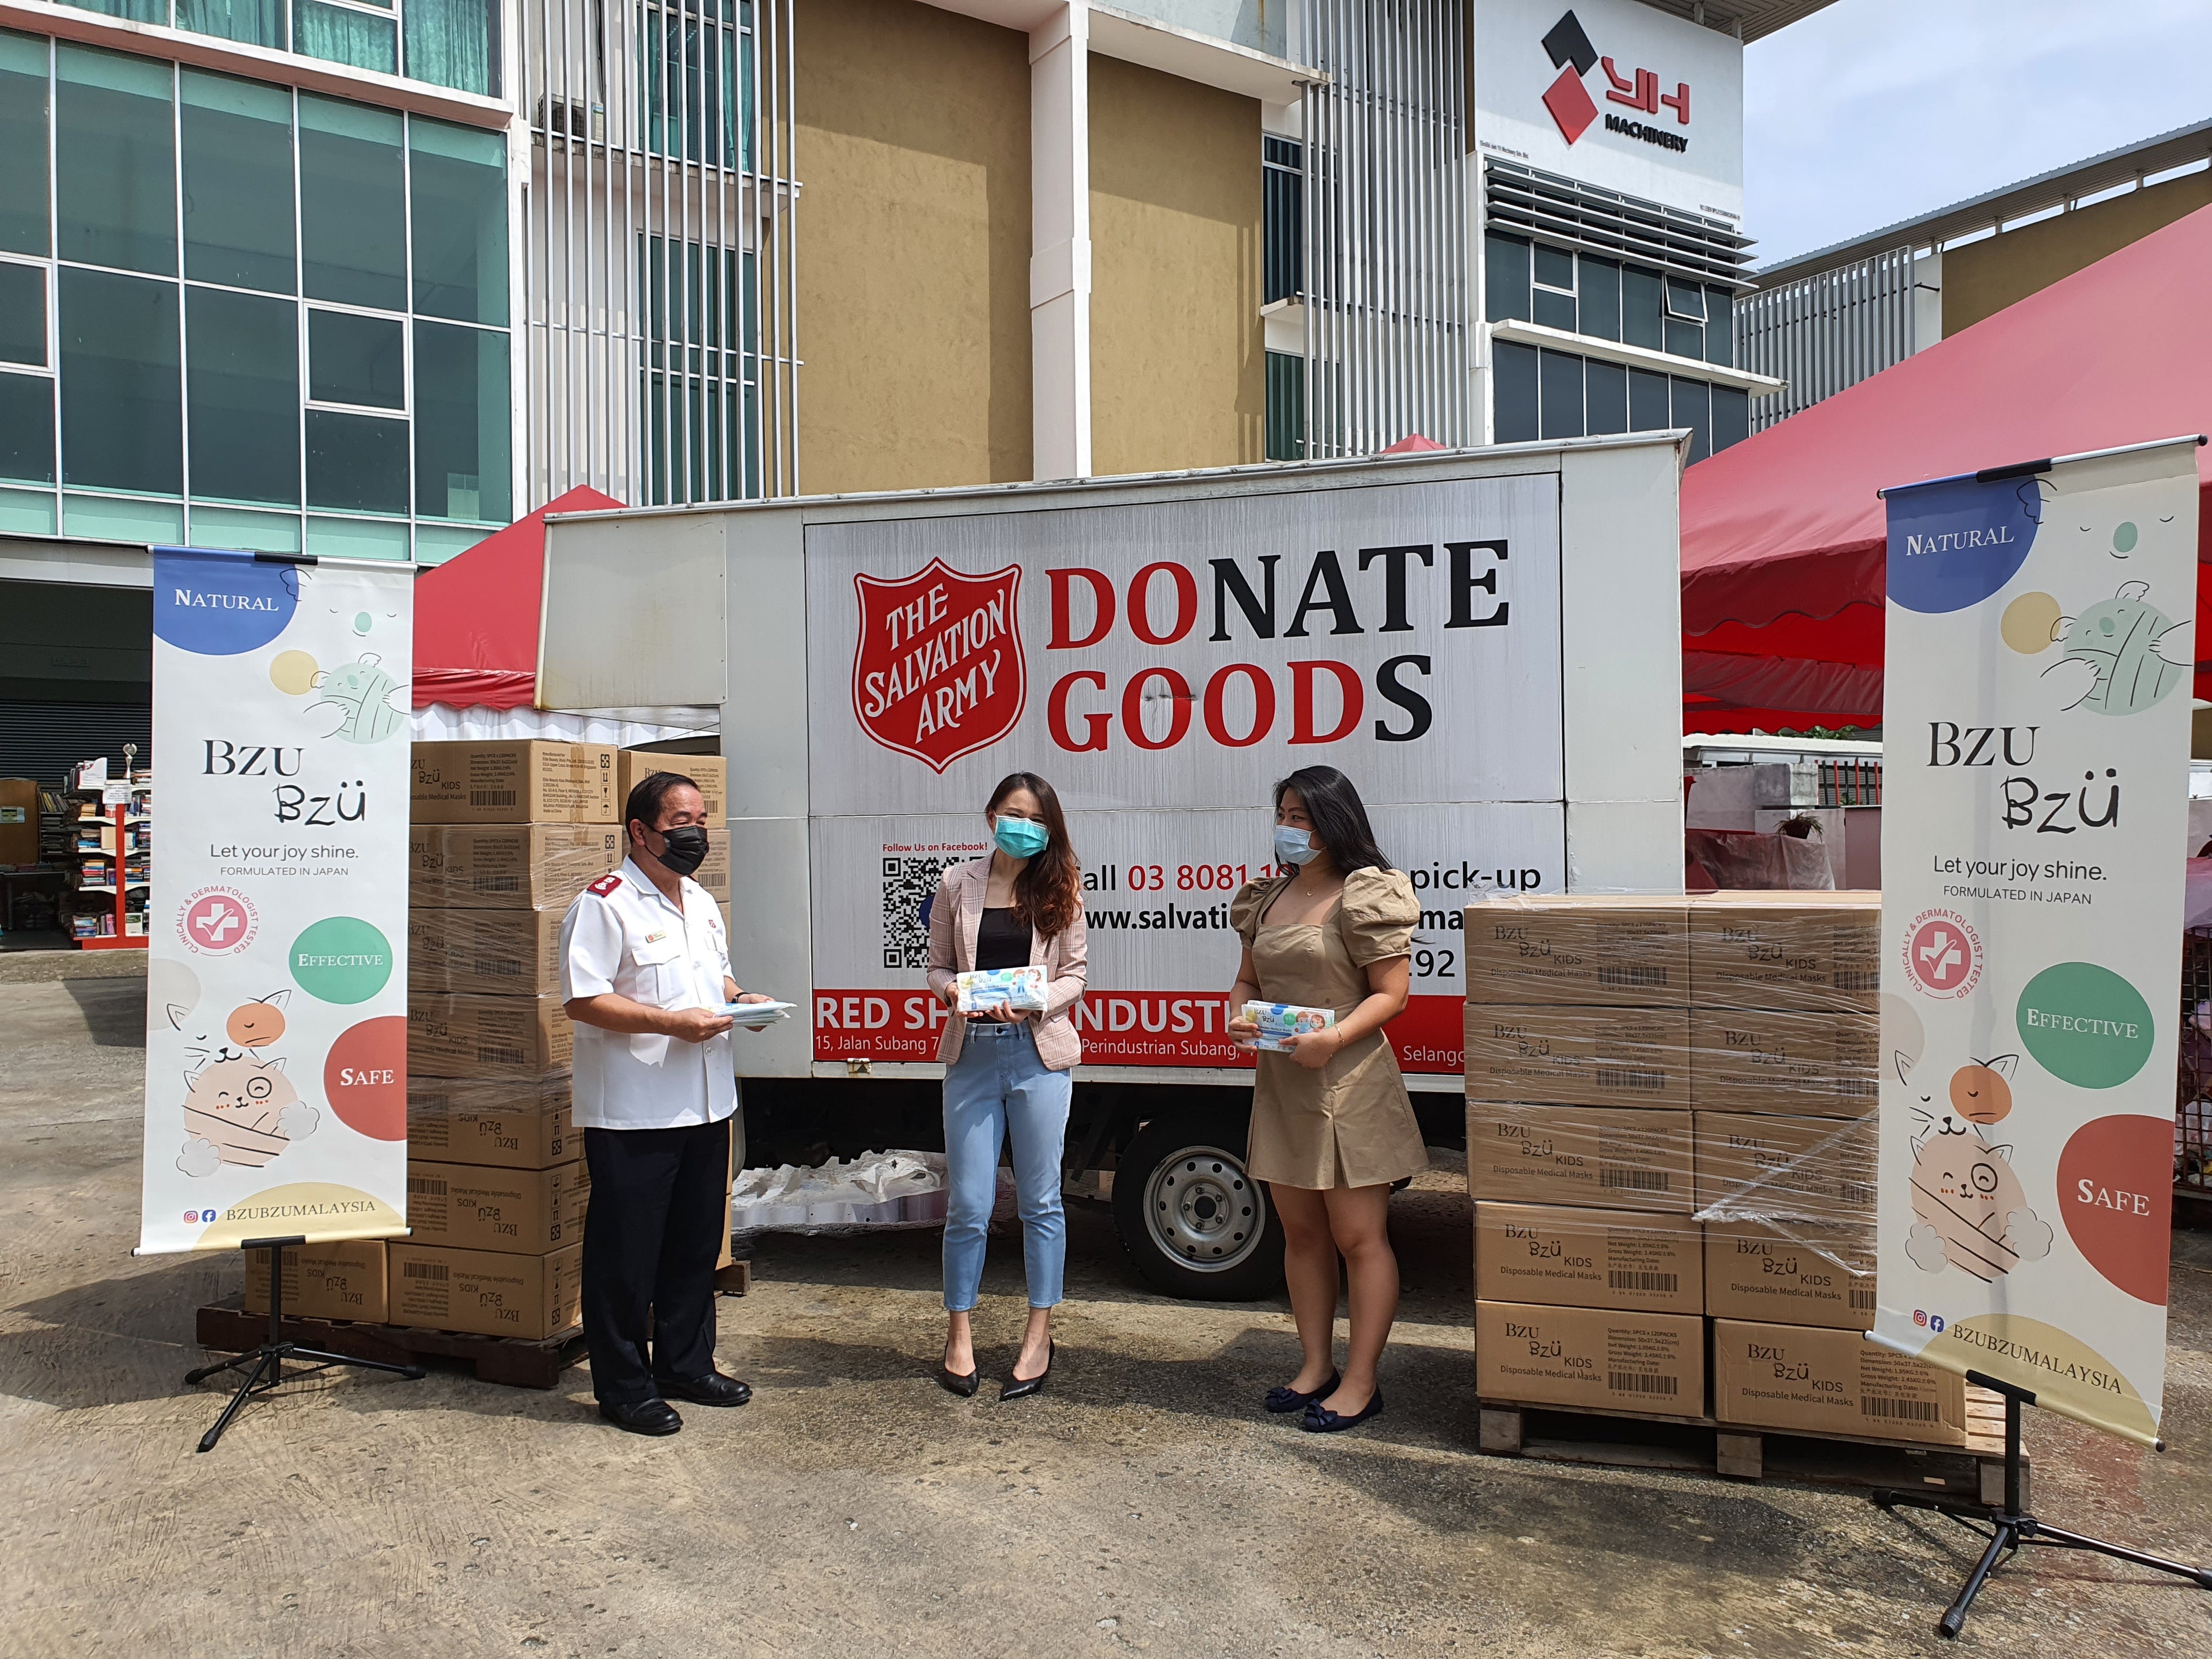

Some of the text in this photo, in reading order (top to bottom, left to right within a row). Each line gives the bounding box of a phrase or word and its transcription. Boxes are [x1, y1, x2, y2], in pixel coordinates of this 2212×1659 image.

[1605, 113, 1689, 153] MACHINERY
[1906, 526, 2015, 556] NATURAL
[175, 589, 279, 612] NATURAL
[1044, 539, 1510, 650] DONATE
[885, 582, 949, 651] THE
[865, 589, 1007, 718] SALVATION
[915, 649, 1001, 745] ARMY
[1047, 654, 1433, 752] GOODS
[1926, 721, 2041, 767] BZU
[202, 740, 305, 777] BZU
[441, 781, 460, 790] KIDS
[210, 844, 359, 861] Let your joy shine.
[883, 843, 911, 851] Follow
[942, 842, 988, 851] Facebook!
[221, 867, 349, 876] FORMULATED IN JAPAN
[1934, 855, 2107, 882] Let your joy shine.
[1084, 865, 1116, 891] all
[1128, 865, 1164, 891] 03
[1177, 864, 1246, 891] 8081
[1410, 861, 1541, 895] pick-up
[1944, 885, 2092, 904] FORMULATED IN JAPAN
[176, 905, 199, 953] CLINICALLY
[191, 885, 259, 922] DERMATOLOGIST
[233, 925, 258, 953] TESTED
[1085, 903, 1234, 930] ww.salvati
[1910, 923, 1916, 931] &
[1915, 908, 1983, 960] DERMATOLOGIST
[298, 953, 382, 967] EFFECTIVE
[1409, 949, 1455, 978] 92
[1554, 954, 1582, 965] KIDS
[1786, 959, 1816, 969] KIDS
[1902, 931, 1922, 991] CLINICALLY
[1535, 968, 1565, 977] Medical
[1567, 969, 1592, 978] Masks
[1800, 974, 1825, 982] Masks
[1956, 964, 1983, 998] TESTED
[817, 997, 949, 1029] RED SH
[1075, 998, 1230, 1033] NDUST
[2027, 1008, 2138, 1039] EFFECTIVE
[449, 1036, 468, 1045] KIDS
[816, 1036, 834, 1052] 15,
[838, 1035, 870, 1050] Jalan
[875, 1036, 926, 1054] Subang
[1082, 1038, 1240, 1060] Perindustrian Subang,
[1403, 1046, 1464, 1066] Selango
[340, 1068, 394, 1086] SAFE
[1490, 1067, 1532, 1077] Disposable
[1534, 1069, 1564, 1077] Medical
[1789, 1064, 1819, 1074] KIDS
[459, 1113, 478, 1122] KIDS
[1498, 1123, 1531, 1138] BZU
[1556, 1155, 1584, 1166] KIDS
[1493, 1165, 1593, 1179] Disposable Medical Masks
[1792, 1169, 1822, 1180] KIDS
[490, 1190, 521, 1199] Disposable
[1806, 1184, 1833, 1194] Masks
[457, 1198, 476, 1207] KIDS
[2077, 1179, 2150, 1217] SAFE
[226, 1200, 376, 1221] BZUBZUMALAYSIA
[1505, 1224, 1539, 1239] BZU
[1564, 1256, 1592, 1267] KIDS
[307, 1268, 325, 1278] KIDS
[471, 1274, 491, 1282] Medical
[492, 1275, 524, 1285] Disposable
[1500, 1266, 1601, 1281] Disposable Medical Masks
[1801, 1274, 1831, 1286] KIDS
[459, 1283, 479, 1293] KIDS
[1731, 1283, 1842, 1300] Disposable Medical Masks
[1505, 1323, 1540, 1338] BZU
[1748, 1344, 1785, 1360] BZU
[1953, 1324, 2122, 1394] BZUBZUMALAYSIA
[1564, 1357, 1592, 1368] KIDS
[1500, 1365, 1601, 1382] Disposable Medical Masks
[1812, 1380, 1843, 1392] KIDS
[1861, 1381, 1903, 1391] Manufacturing
[1742, 1388, 1853, 1406] Disposable Medical Masks
